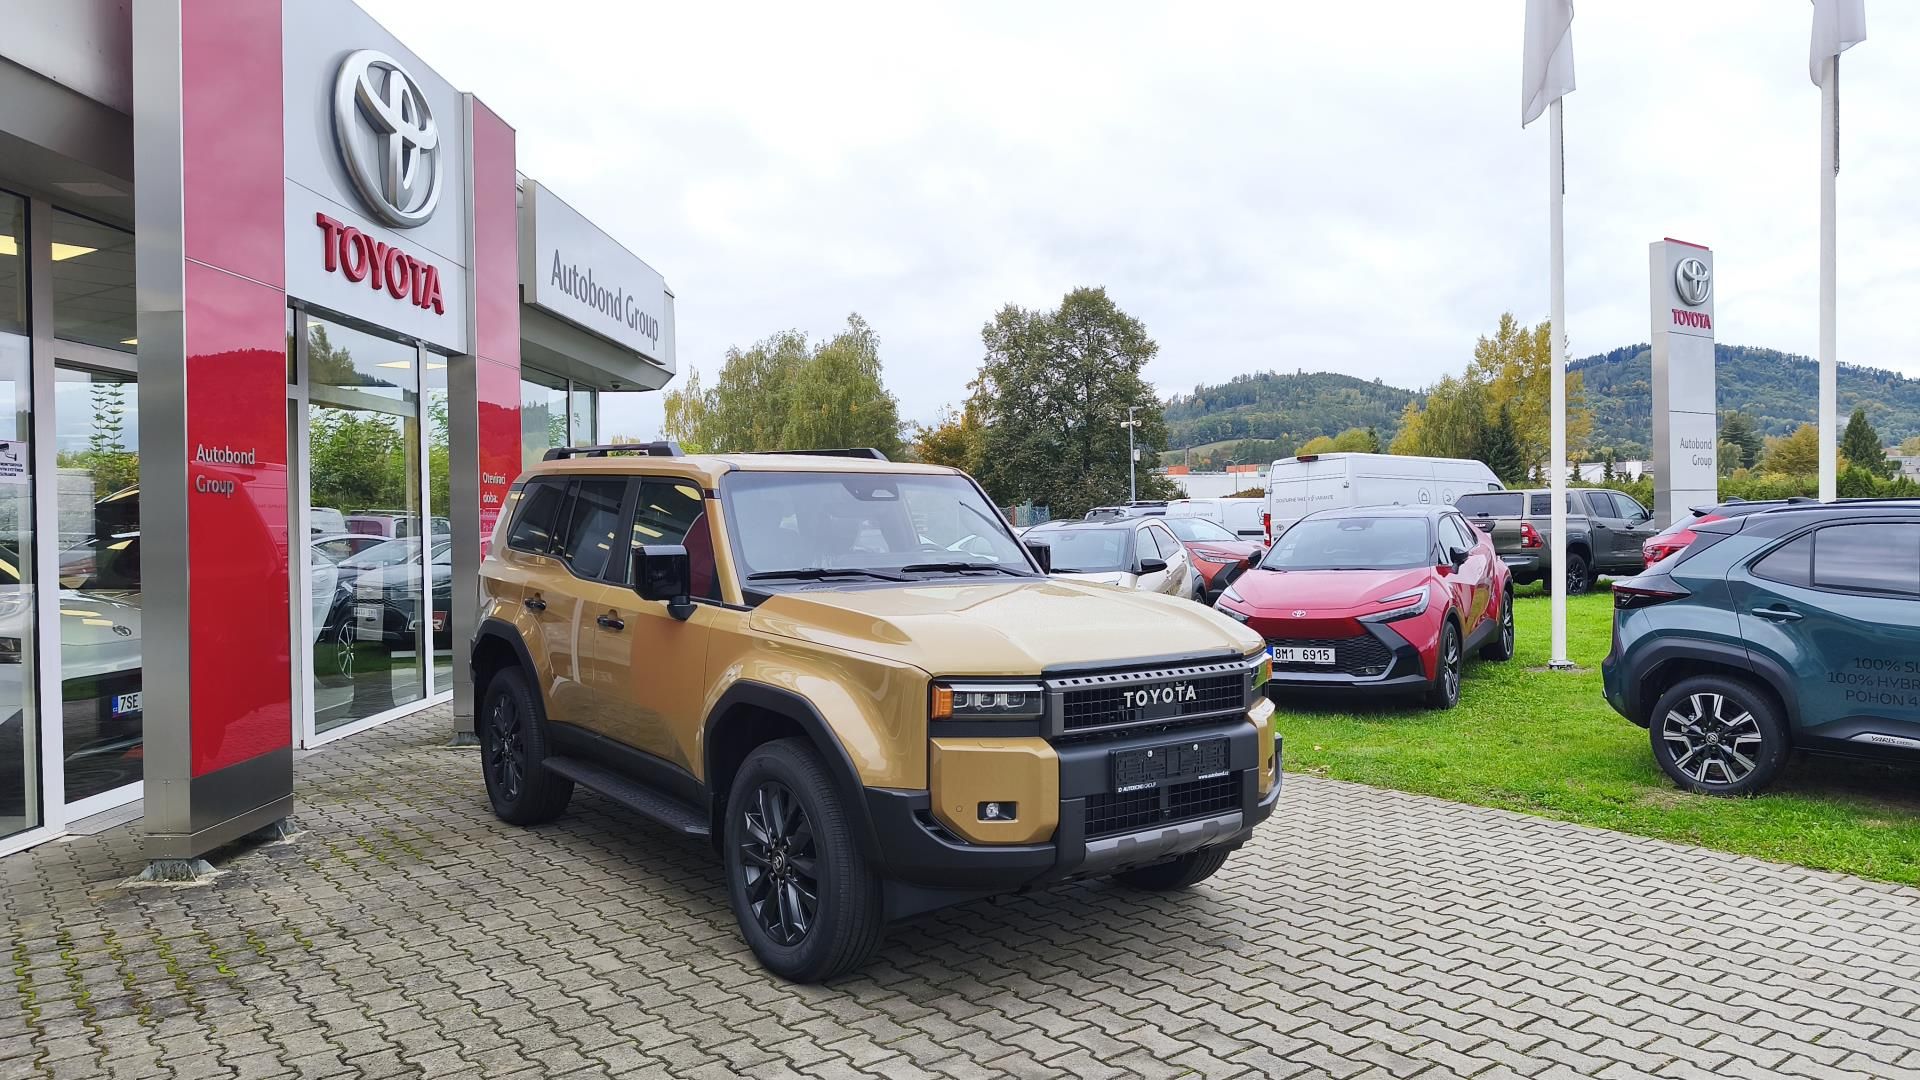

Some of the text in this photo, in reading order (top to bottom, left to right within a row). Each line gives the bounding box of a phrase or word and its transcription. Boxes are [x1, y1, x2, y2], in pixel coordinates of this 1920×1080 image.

[316, 211, 445, 316] TOYOTA
[551, 248, 660, 351] Autobond Group
[1671, 308, 1712, 330] TOYOTA
[1679, 436, 1713, 450] Autobond
[196, 443, 256, 465] Autobond
[1691, 454, 1713, 470] Group
[196, 474, 235, 499] Group
[1275, 648, 1330, 661] 8M1 6915
[1855, 658, 1900, 672] 100%
[1828, 672, 1873, 686] 100%
[120, 693, 139, 712] 7SE
[1123, 685, 1197, 707] TOYOTA
[1846, 690, 1904, 705] POHON
